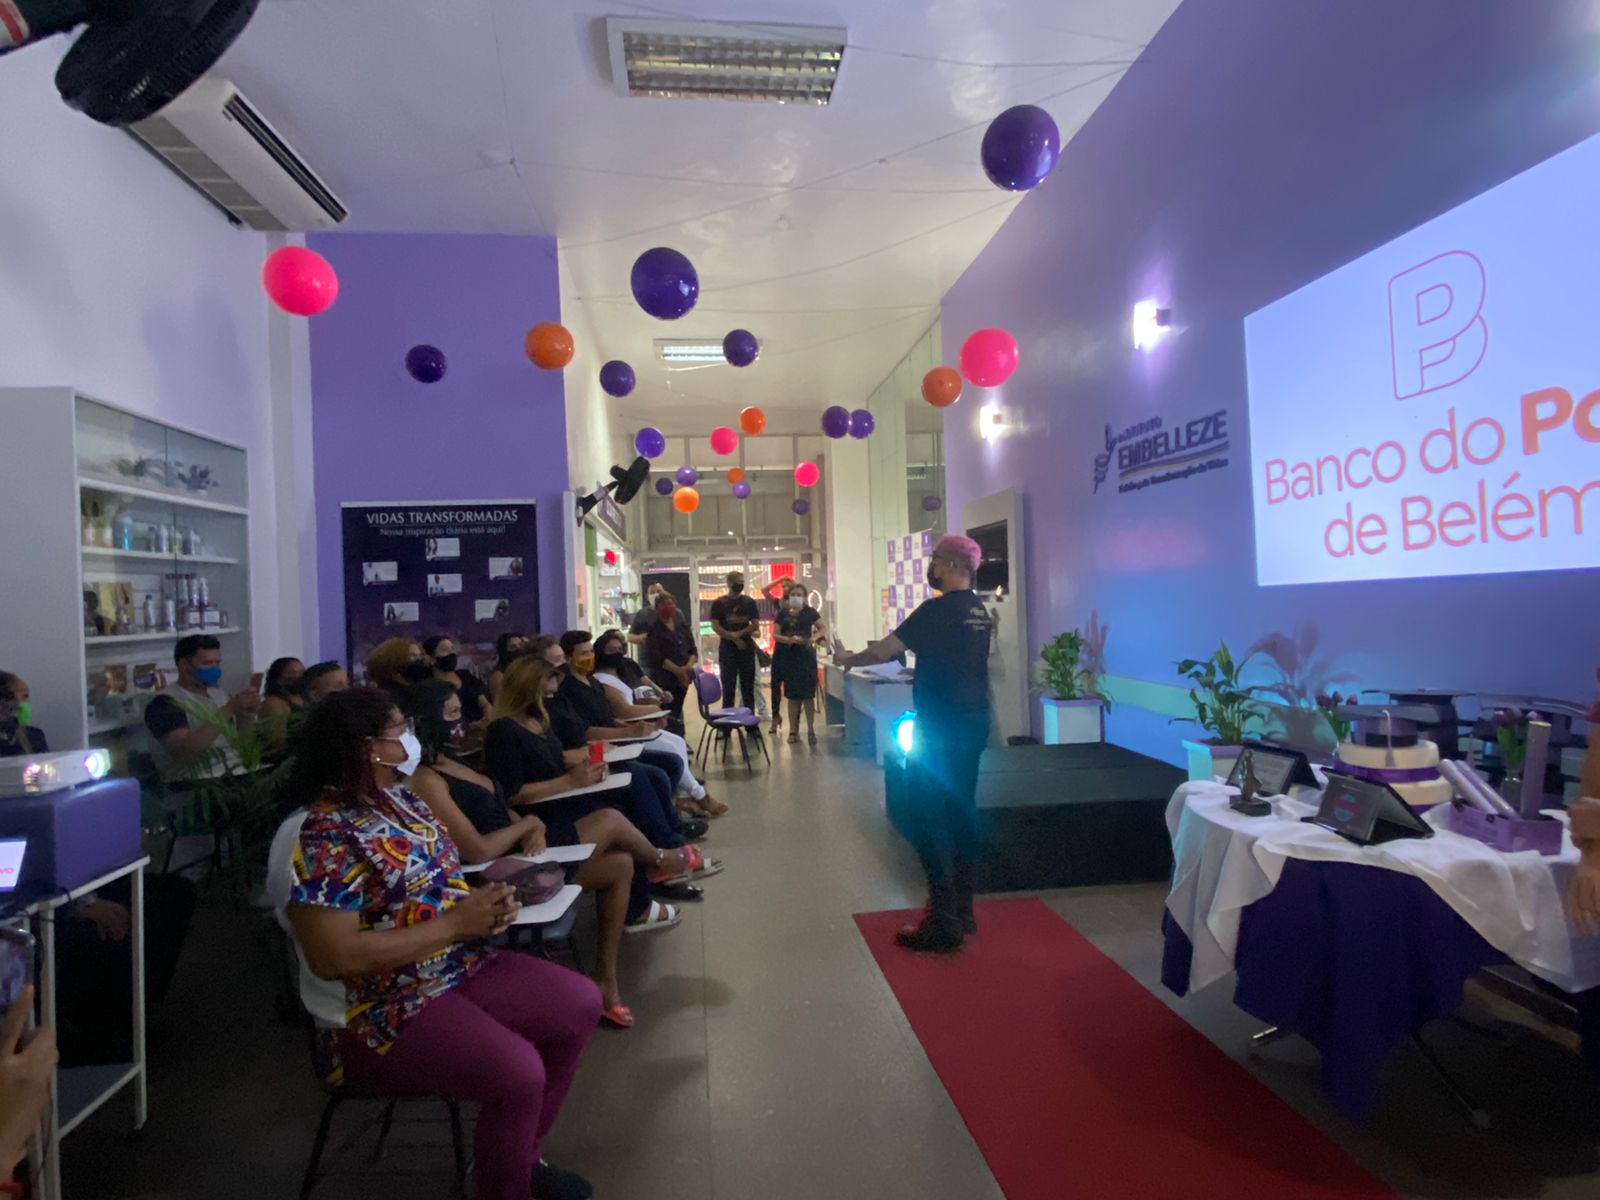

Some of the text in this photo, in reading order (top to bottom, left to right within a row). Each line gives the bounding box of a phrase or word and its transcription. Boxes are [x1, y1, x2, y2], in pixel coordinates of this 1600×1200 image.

[1118, 409, 1228, 470] EMBELLEZE
[1264, 440, 1407, 505] Banco
[1419, 407, 1505, 475] do
[366, 510, 518, 524] VIDAS TRANSFORMADAS
[1323, 471, 1600, 559] de Belém
